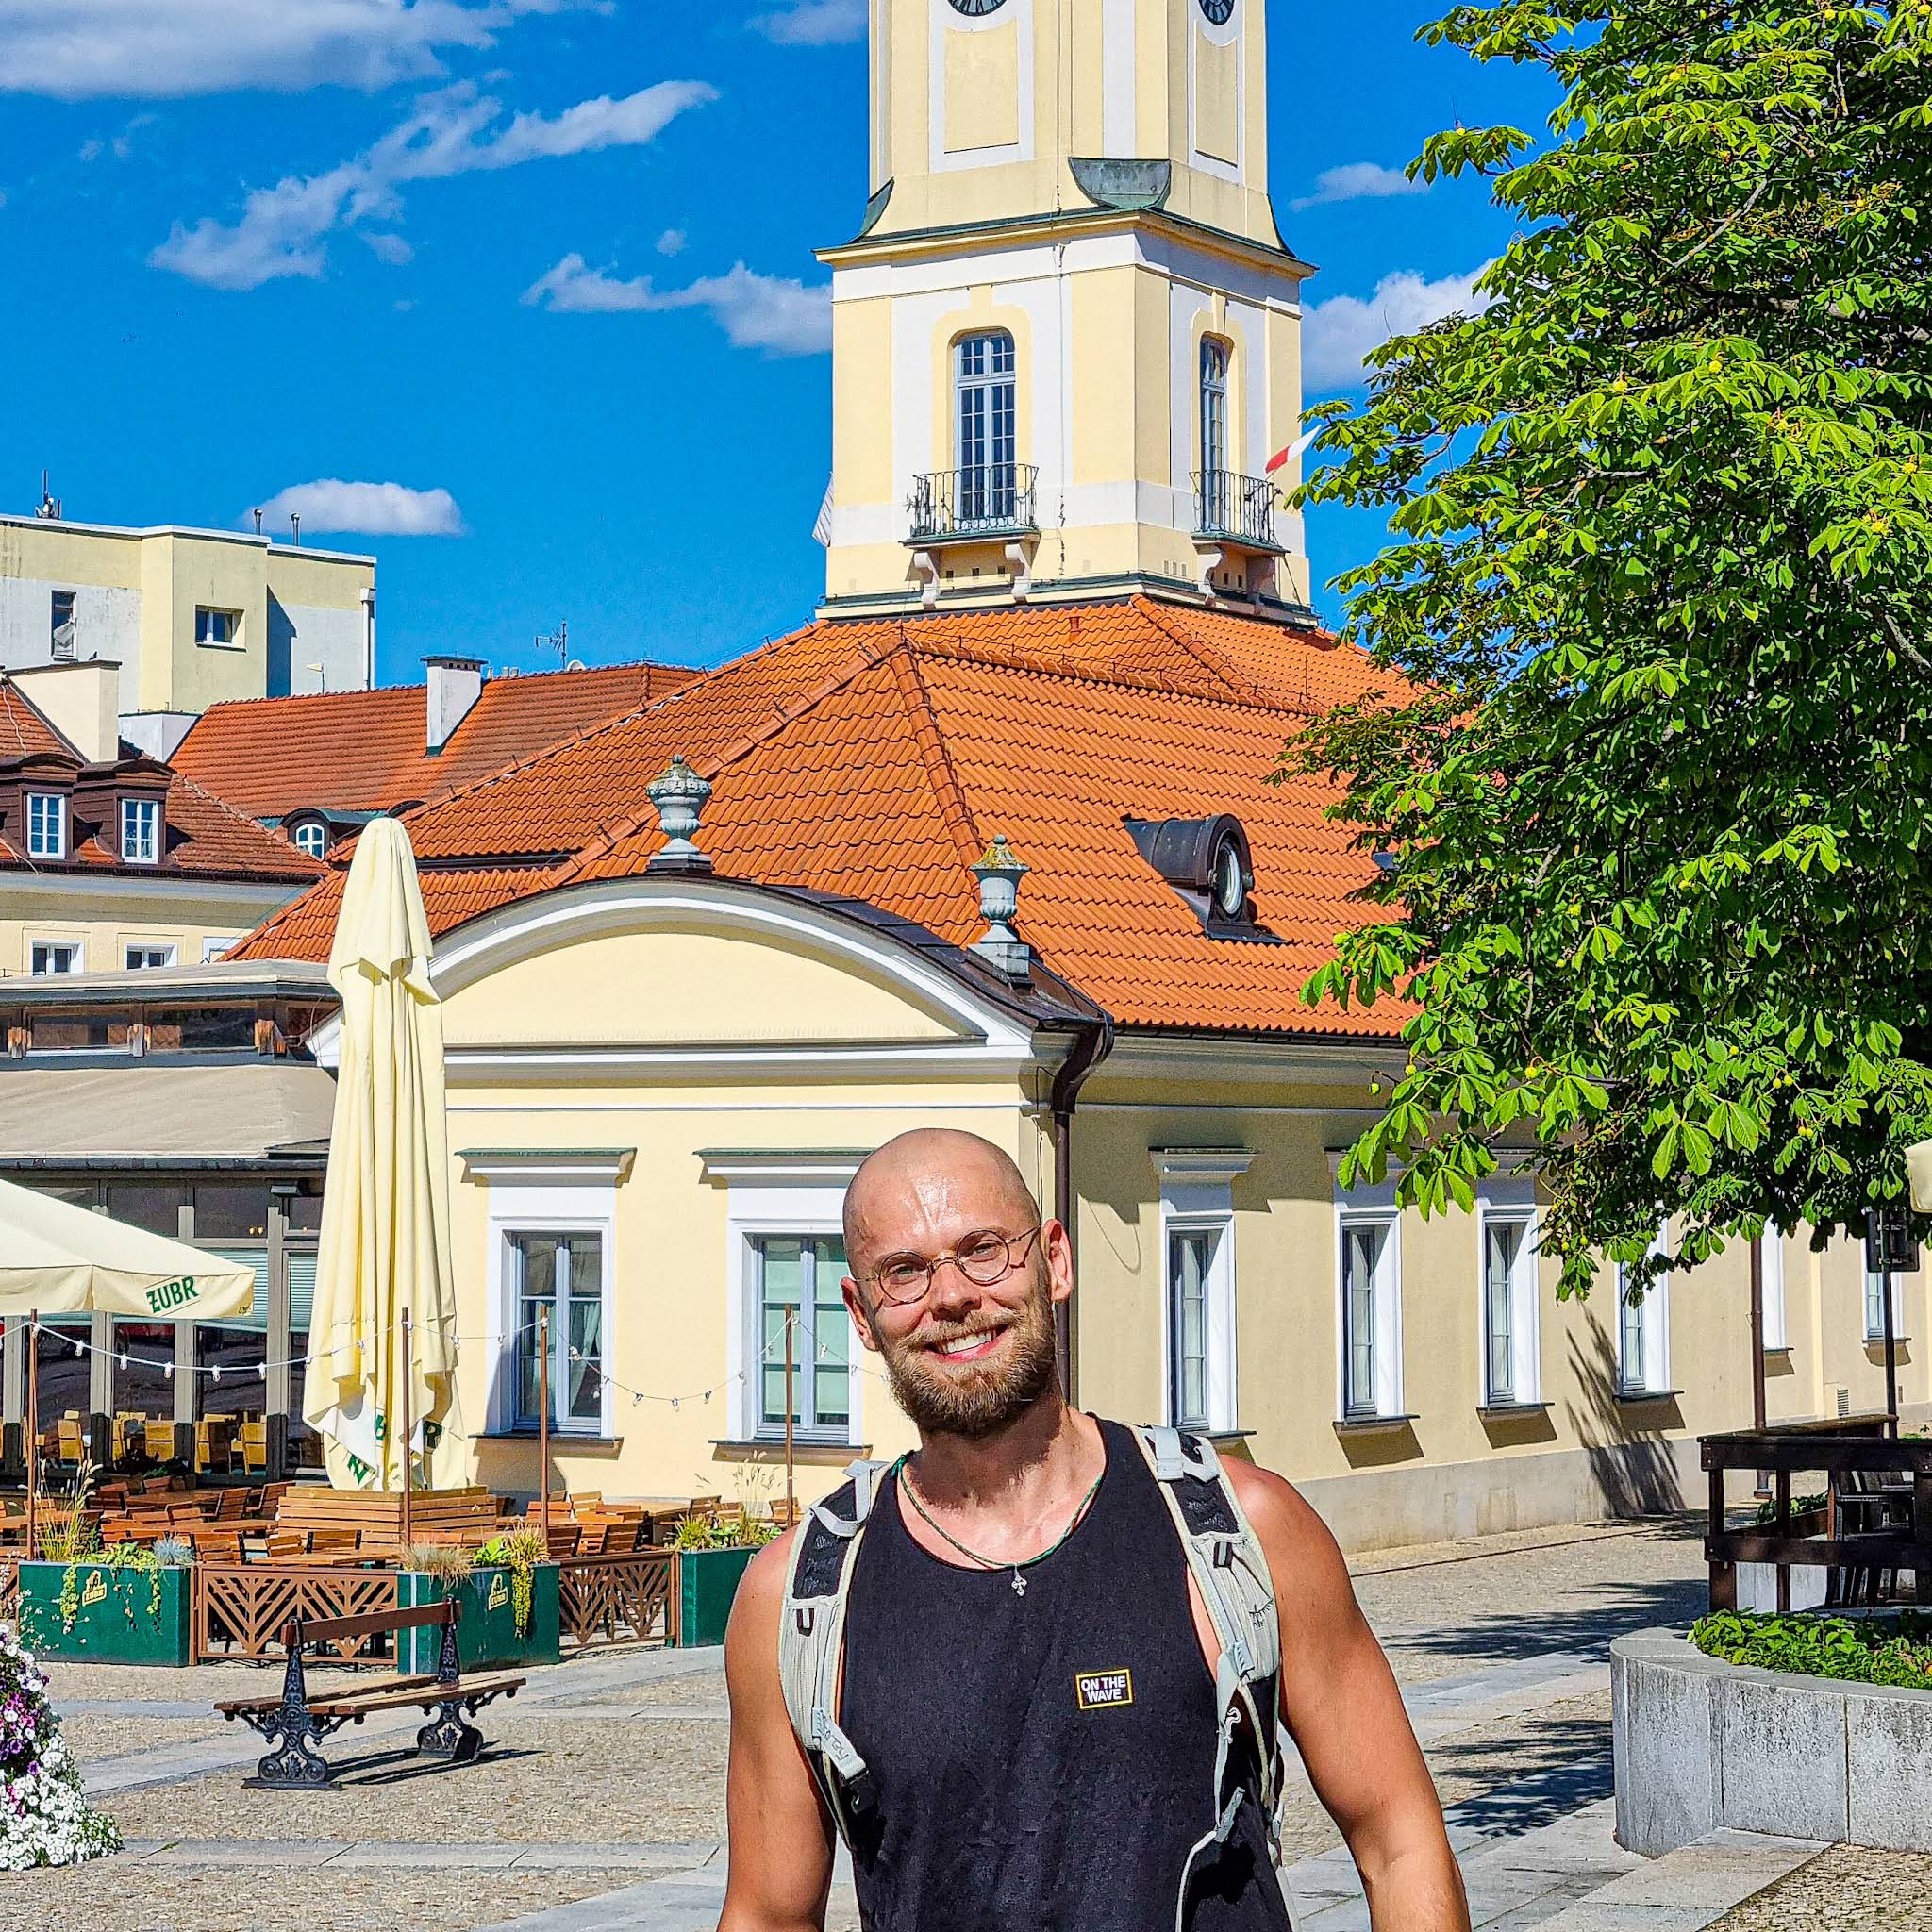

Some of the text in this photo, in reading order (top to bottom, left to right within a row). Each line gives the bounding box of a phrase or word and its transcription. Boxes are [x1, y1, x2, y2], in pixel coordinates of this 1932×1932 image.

[1081, 1675, 1126, 1691] ON THE
[1087, 1689, 1122, 1703] WAVE
